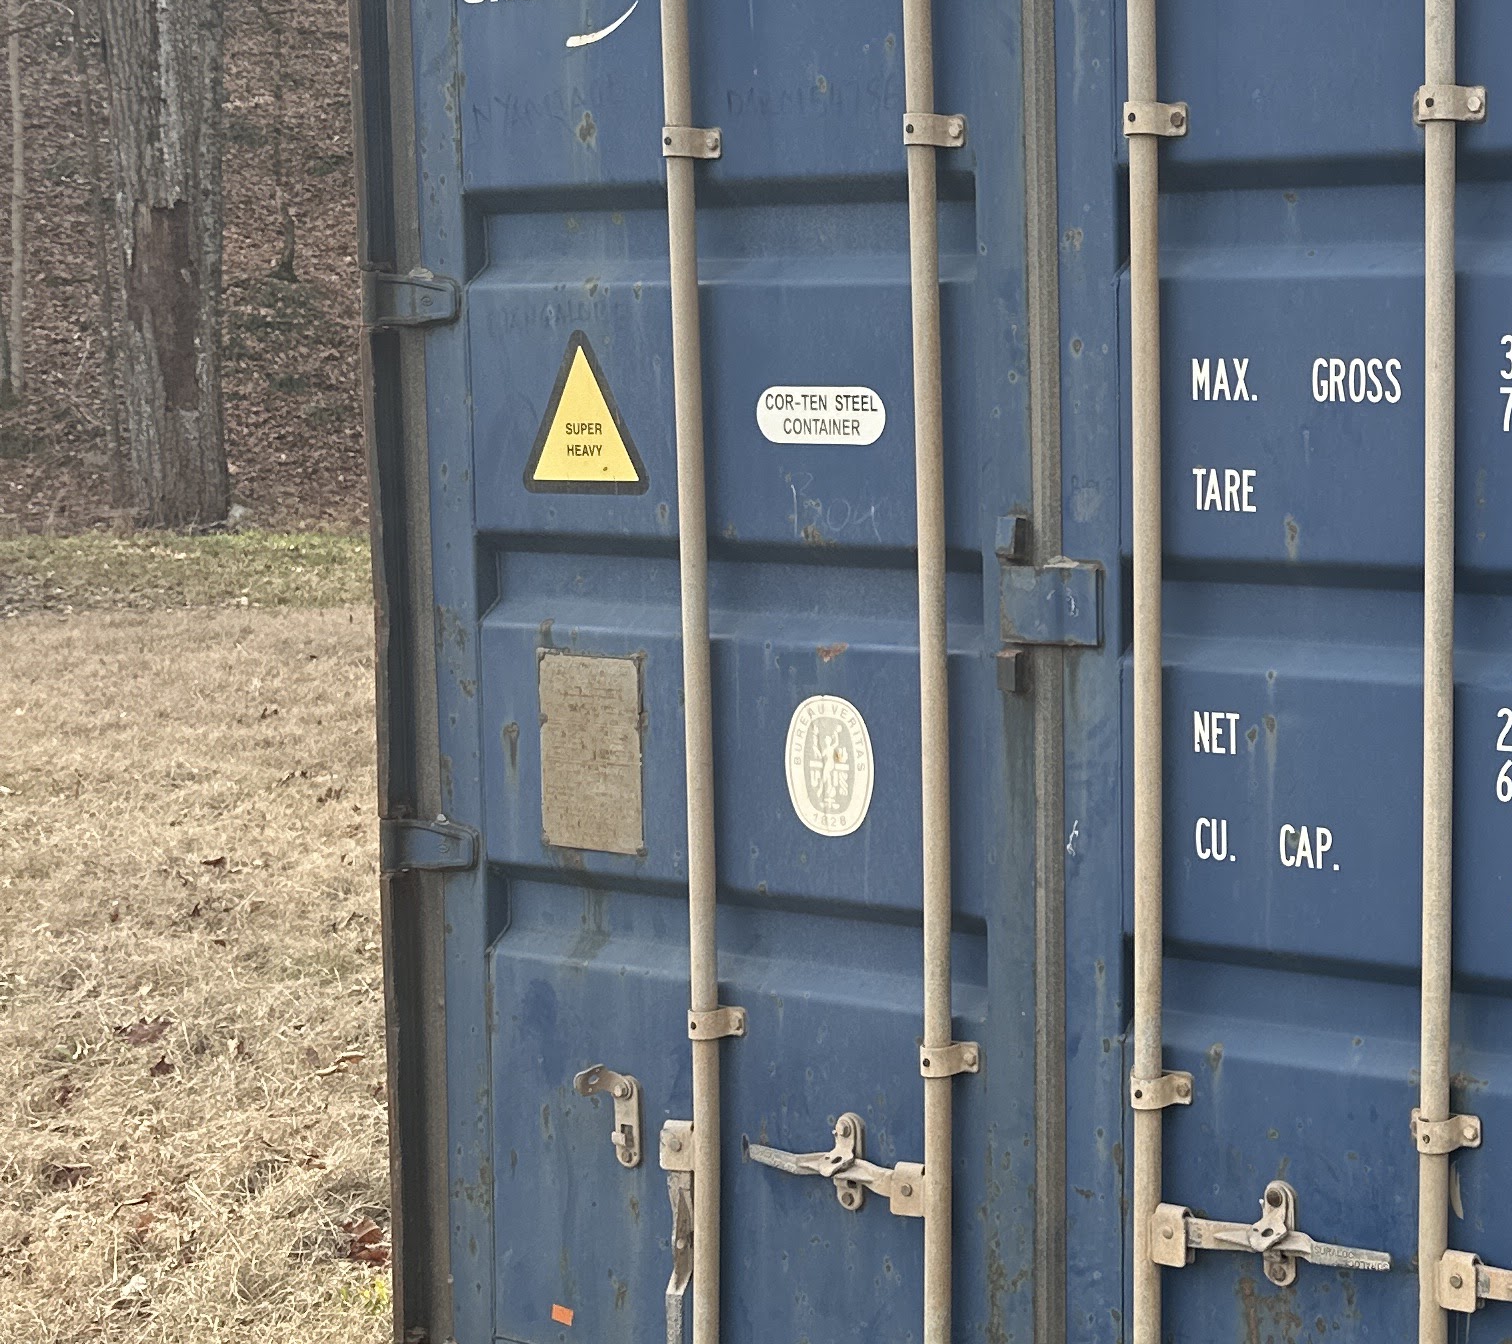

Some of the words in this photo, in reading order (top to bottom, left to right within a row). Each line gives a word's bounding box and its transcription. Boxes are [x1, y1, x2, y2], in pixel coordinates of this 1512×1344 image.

[1192, 358, 1258, 402] MAX.
[1312, 358, 1402, 404] GROSS
[765, 393, 828, 411] COR-TEN
[835, 394, 878, 412] STEEL
[565, 422, 603, 436] SUPER
[783, 418, 861, 436] CONTAINER
[566, 444, 603, 457] HEAVY
[1192, 468, 1257, 513] TARE
[793, 703, 825, 766] BUREAU
[832, 705, 866, 773] VERITAS
[1193, 710, 1240, 755] NET
[813, 812, 848, 827] 1828
[1195, 817, 1236, 862] CU.
[1279, 823, 1340, 871] CAP.
